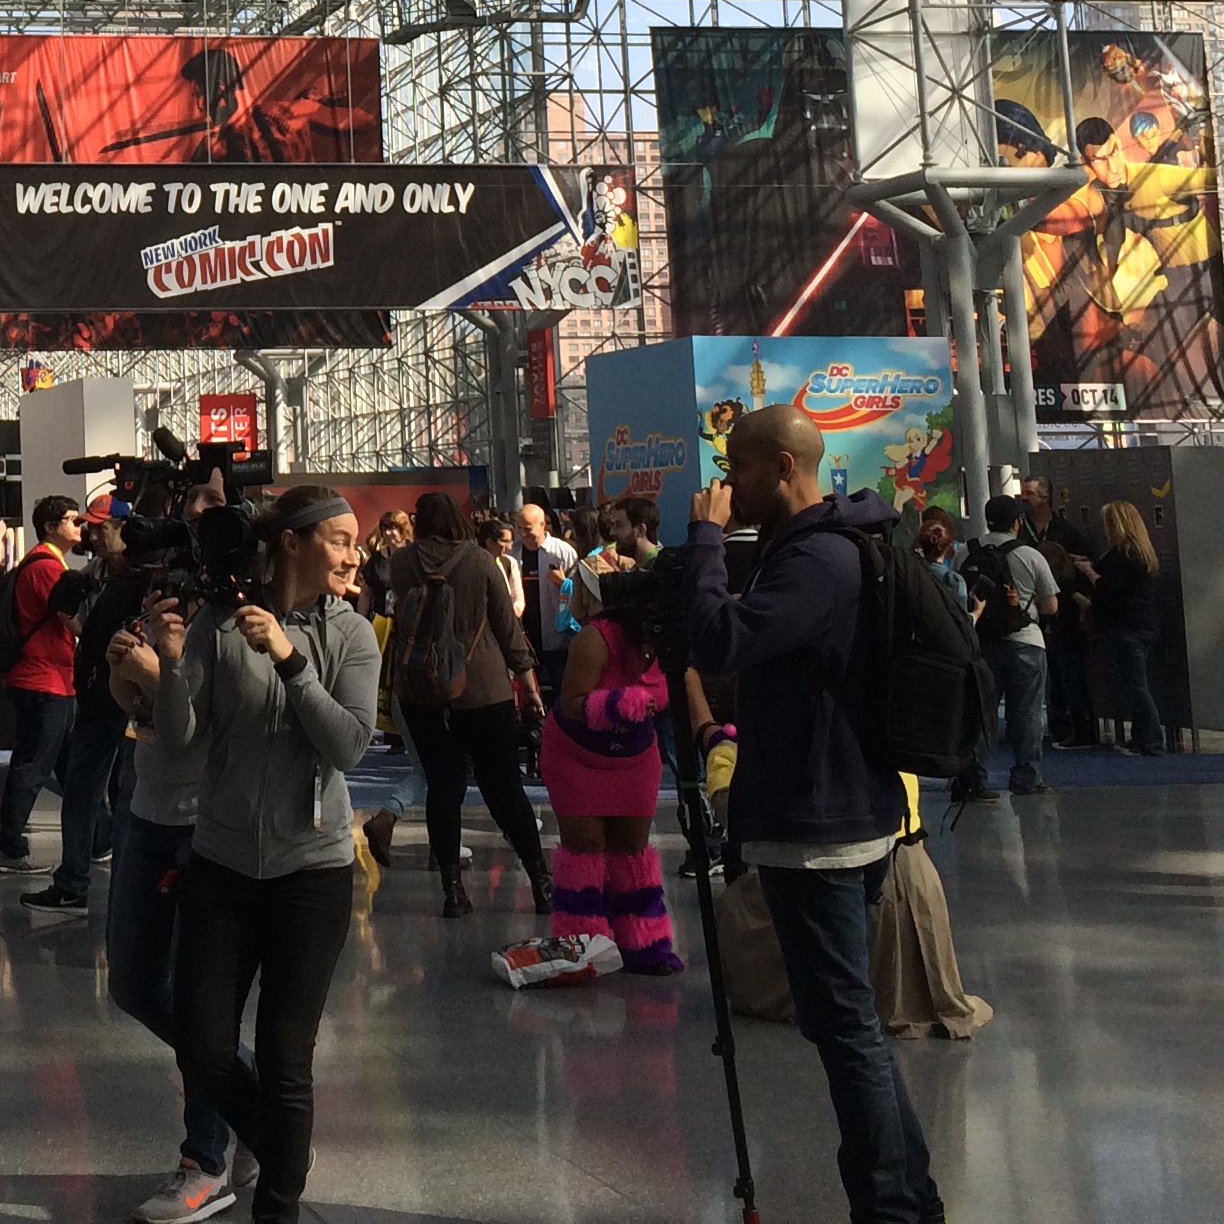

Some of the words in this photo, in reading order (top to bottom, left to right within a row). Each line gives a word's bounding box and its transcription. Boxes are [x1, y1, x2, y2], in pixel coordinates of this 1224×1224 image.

[15, 182, 156, 214] WELCOME
[162, 182, 202, 214] TO
[209, 182, 265, 214] THE
[271, 182, 329, 214] ONE
[334, 182, 395, 214] AND
[402, 182, 475, 214] ONLY
[143, 242, 175, 267] NEW
[179, 228, 220, 255] YORK
[153, 240, 256, 292] COMIC
[265, 228, 331, 272] CON
[828, 366, 850, 377] DC
[854, 395, 901, 409] GIRLS
[1071, 389, 1098, 405] OCT
[1102, 389, 1118, 405] 14
[616, 428, 628, 446] DC
[631, 470, 662, 492] GIRLS
